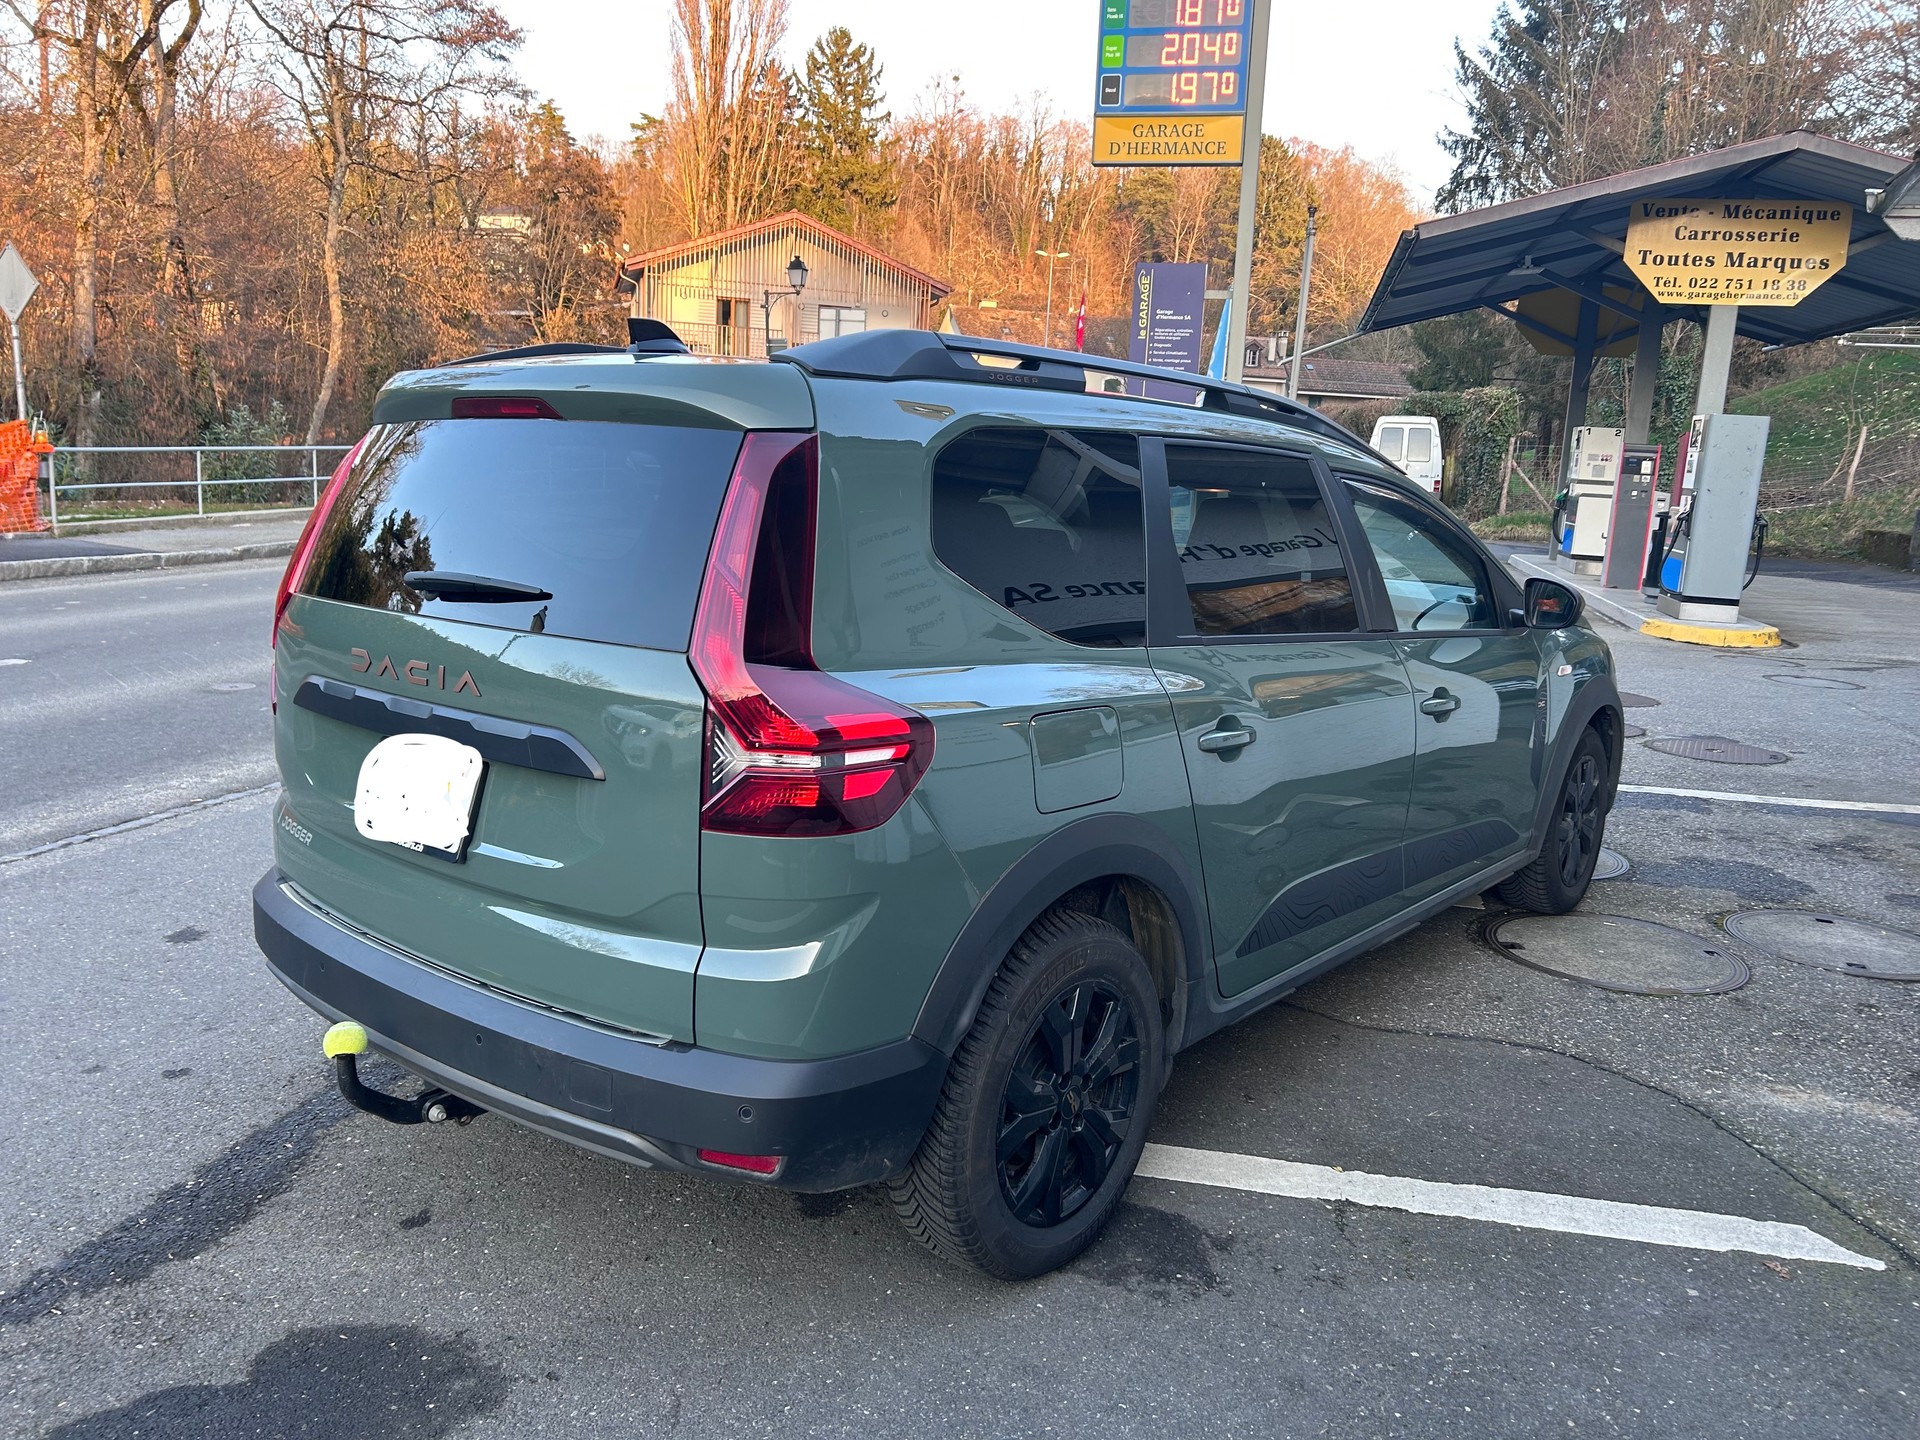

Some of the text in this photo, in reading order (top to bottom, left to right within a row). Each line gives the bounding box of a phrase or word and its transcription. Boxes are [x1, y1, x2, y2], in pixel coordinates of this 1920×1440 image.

[1161, 32, 1237, 65] 2.040
[1171, 71, 1235, 103] 1.970
[1132, 123, 1205, 138] GARAGE
[1108, 141, 1227, 155] D'HERMANCE
[1642, 203, 1700, 219] Vente
[1722, 204, 1841, 224] Mécanique
[1674, 225, 1800, 243] Carrosserie
[1638, 249, 1830, 274] Toutes Marques
[1653, 276, 1807, 291] Tél. 022 751 18 38
[1657, 290, 1800, 300] www.garagehermance.ch
[1137, 275, 1150, 340] le GARAGE
[989, 373, 1038, 384] JOGGER
[1586, 428, 1591, 436] 1
[1615, 429, 1622, 437] 2
[351, 647, 482, 697] DACIA
[281, 815, 313, 846] JOGGER
